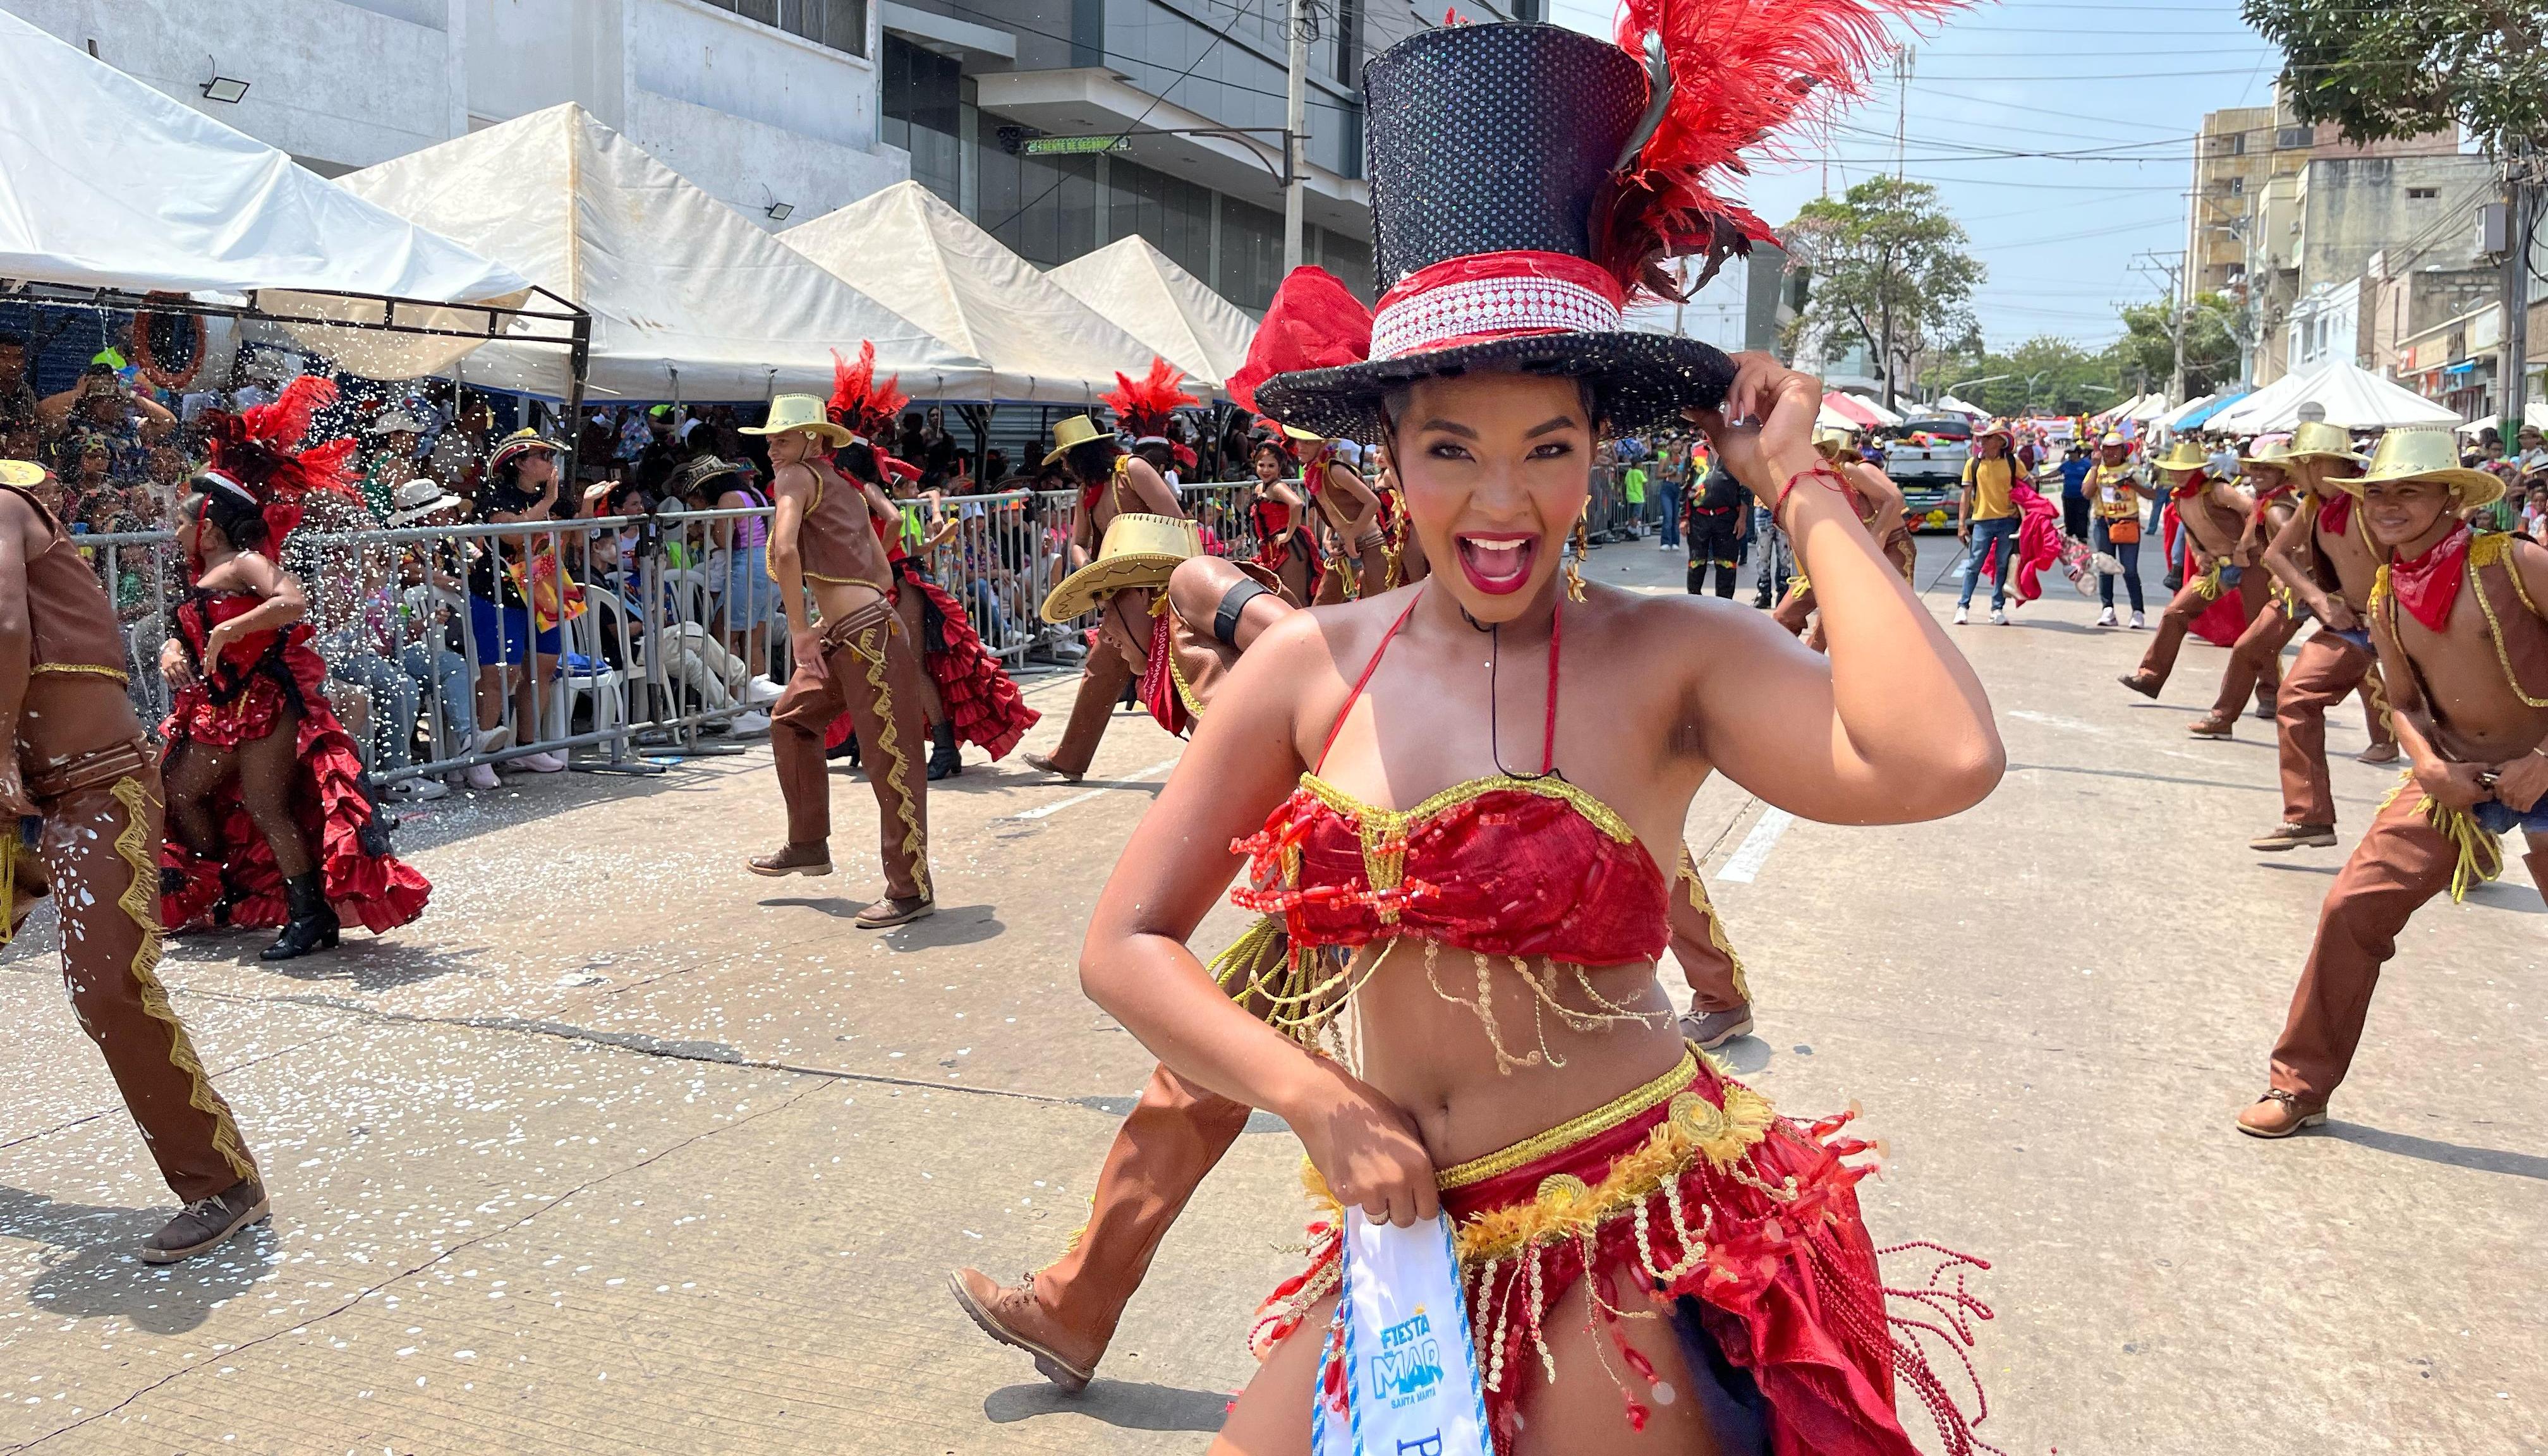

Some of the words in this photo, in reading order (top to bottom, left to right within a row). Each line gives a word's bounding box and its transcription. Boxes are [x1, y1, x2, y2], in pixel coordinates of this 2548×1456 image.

[1038, 140, 1066, 150] FRENTE
[1067, 140, 1076, 150] DE
[1381, 1314, 1431, 1349] FIESTA
[1371, 1338, 1444, 1399] MAR
[1391, 1395, 1416, 1409] SANTA
[1417, 1387, 1436, 1403] MARTA
